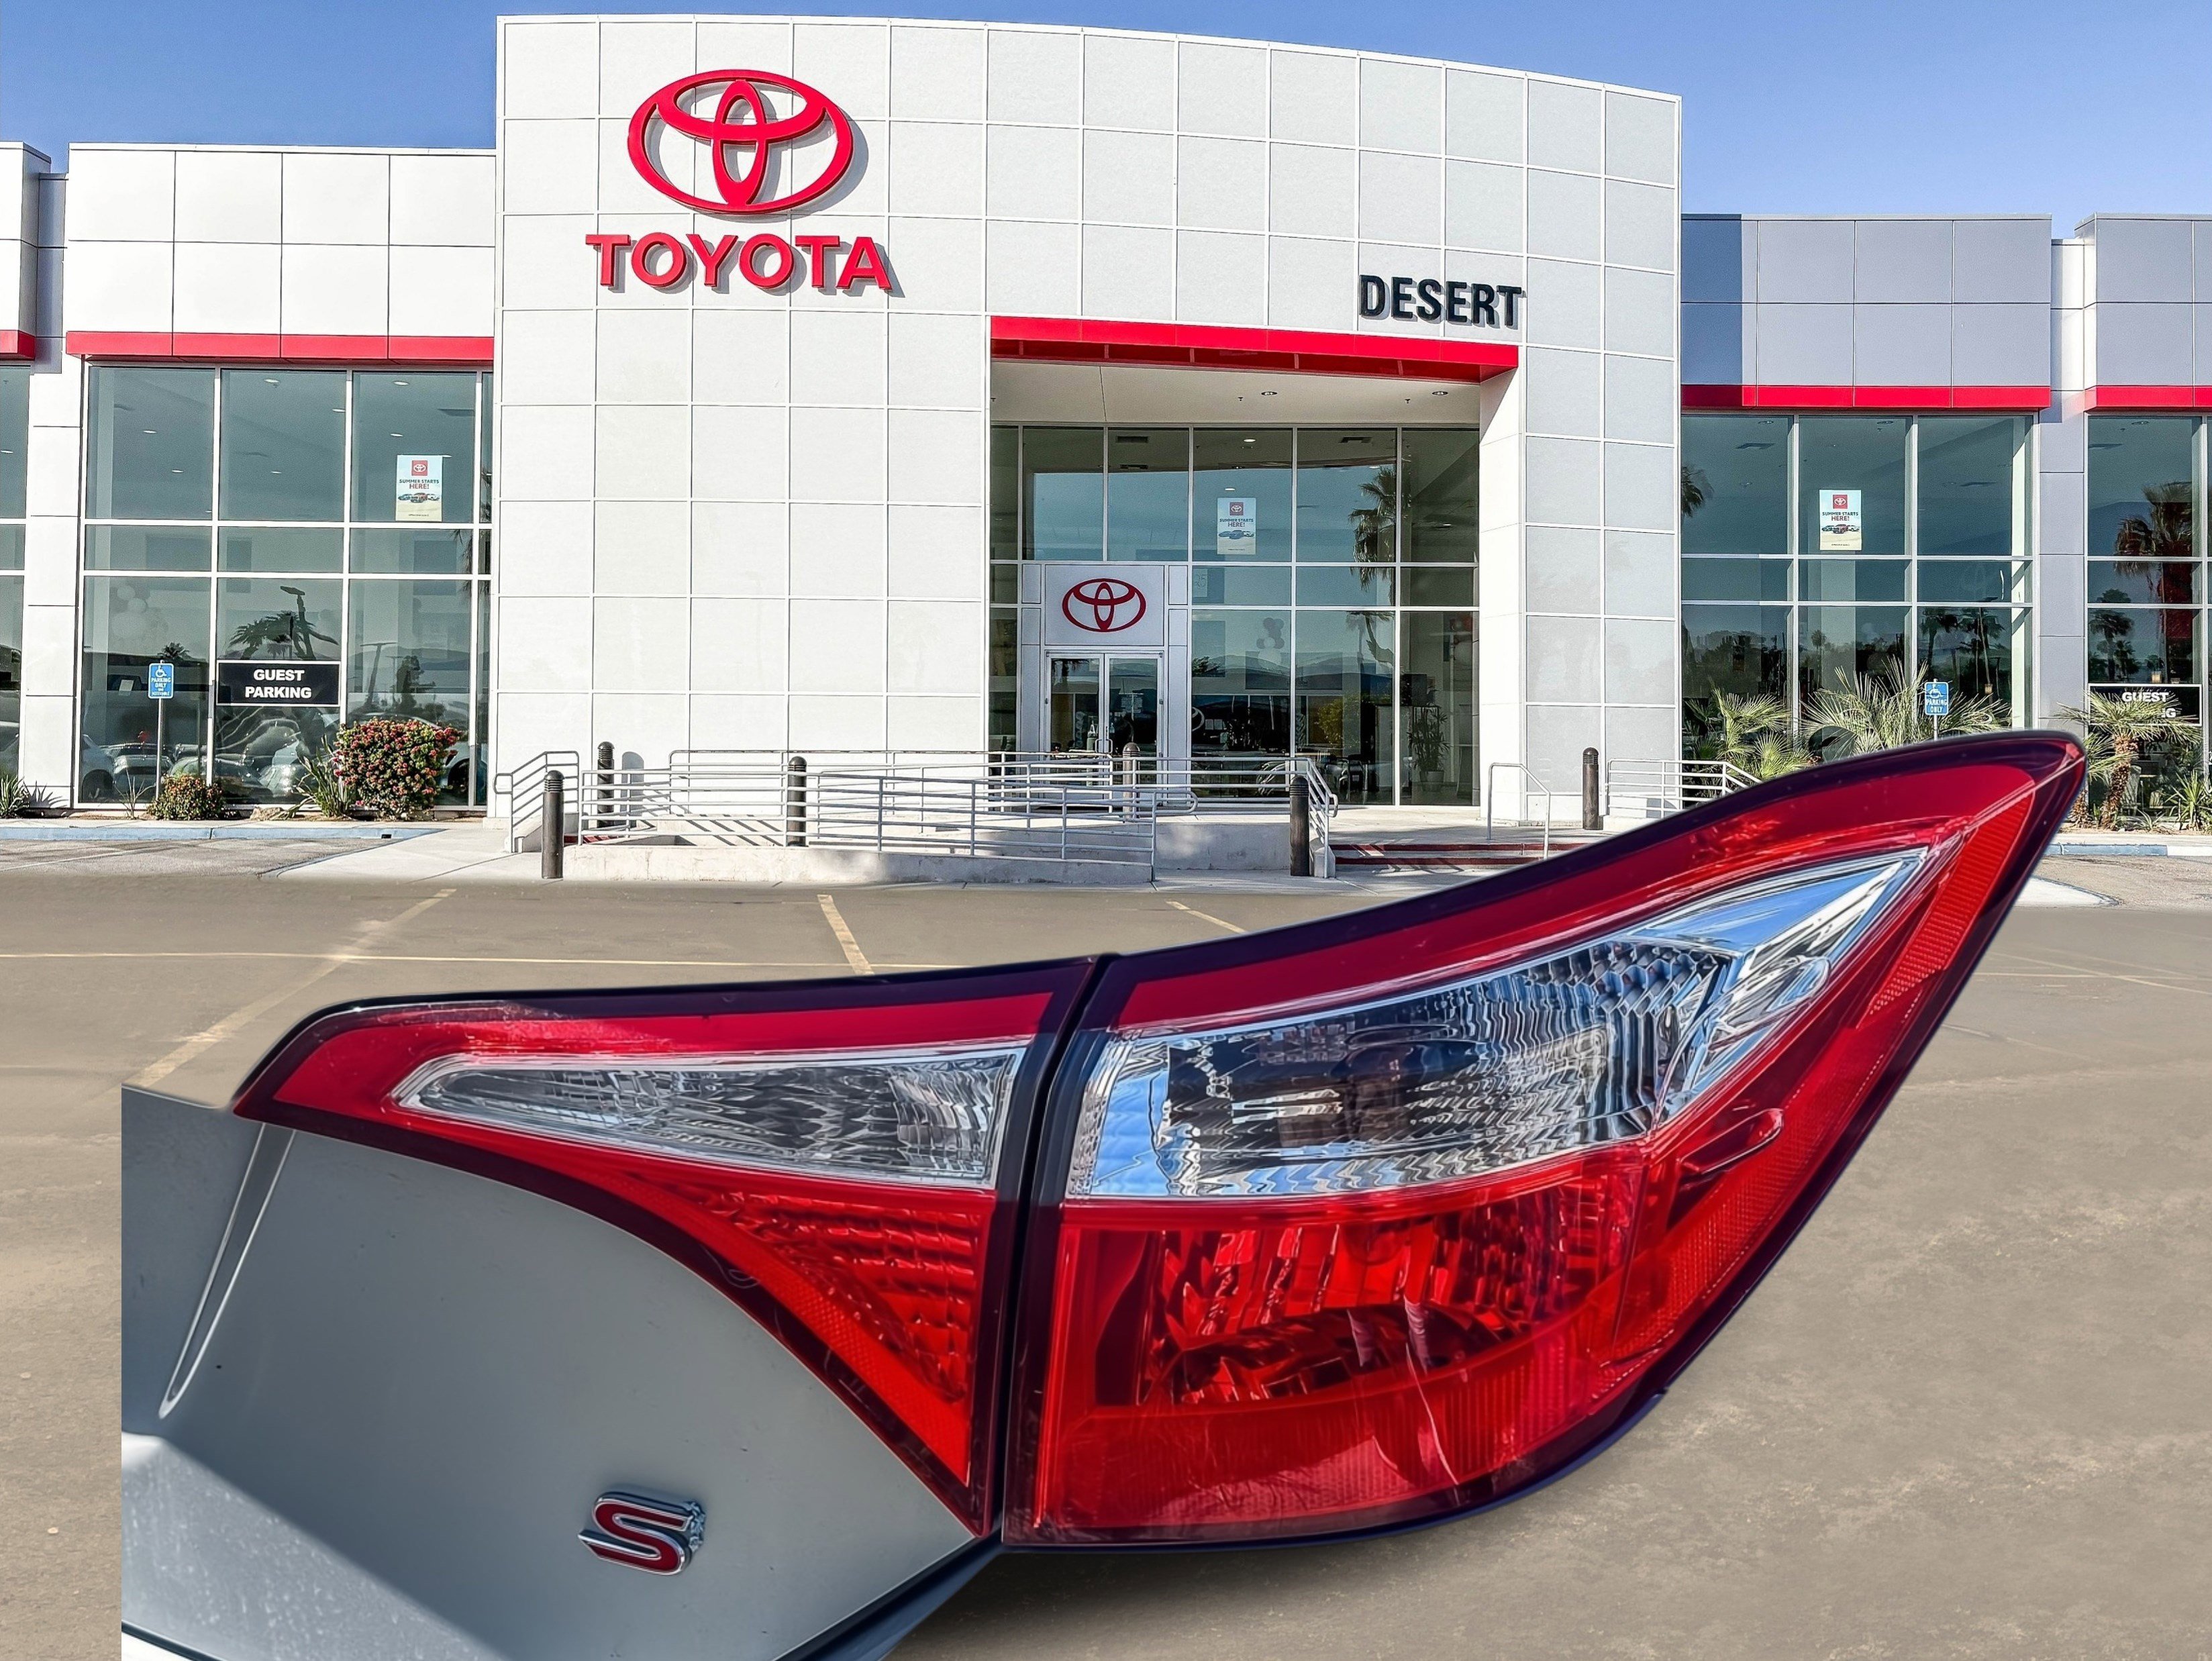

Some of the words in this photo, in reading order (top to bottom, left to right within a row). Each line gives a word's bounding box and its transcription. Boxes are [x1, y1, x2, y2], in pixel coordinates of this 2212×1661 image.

[585, 232, 893, 290] TOYOTA
[1359, 274, 1521, 326] DESERT
[253, 669, 305, 681] GUEST
[245, 686, 312, 699] PARKING
[2121, 691, 2169, 703] GUEST
[578, 1491, 705, 1575] S
